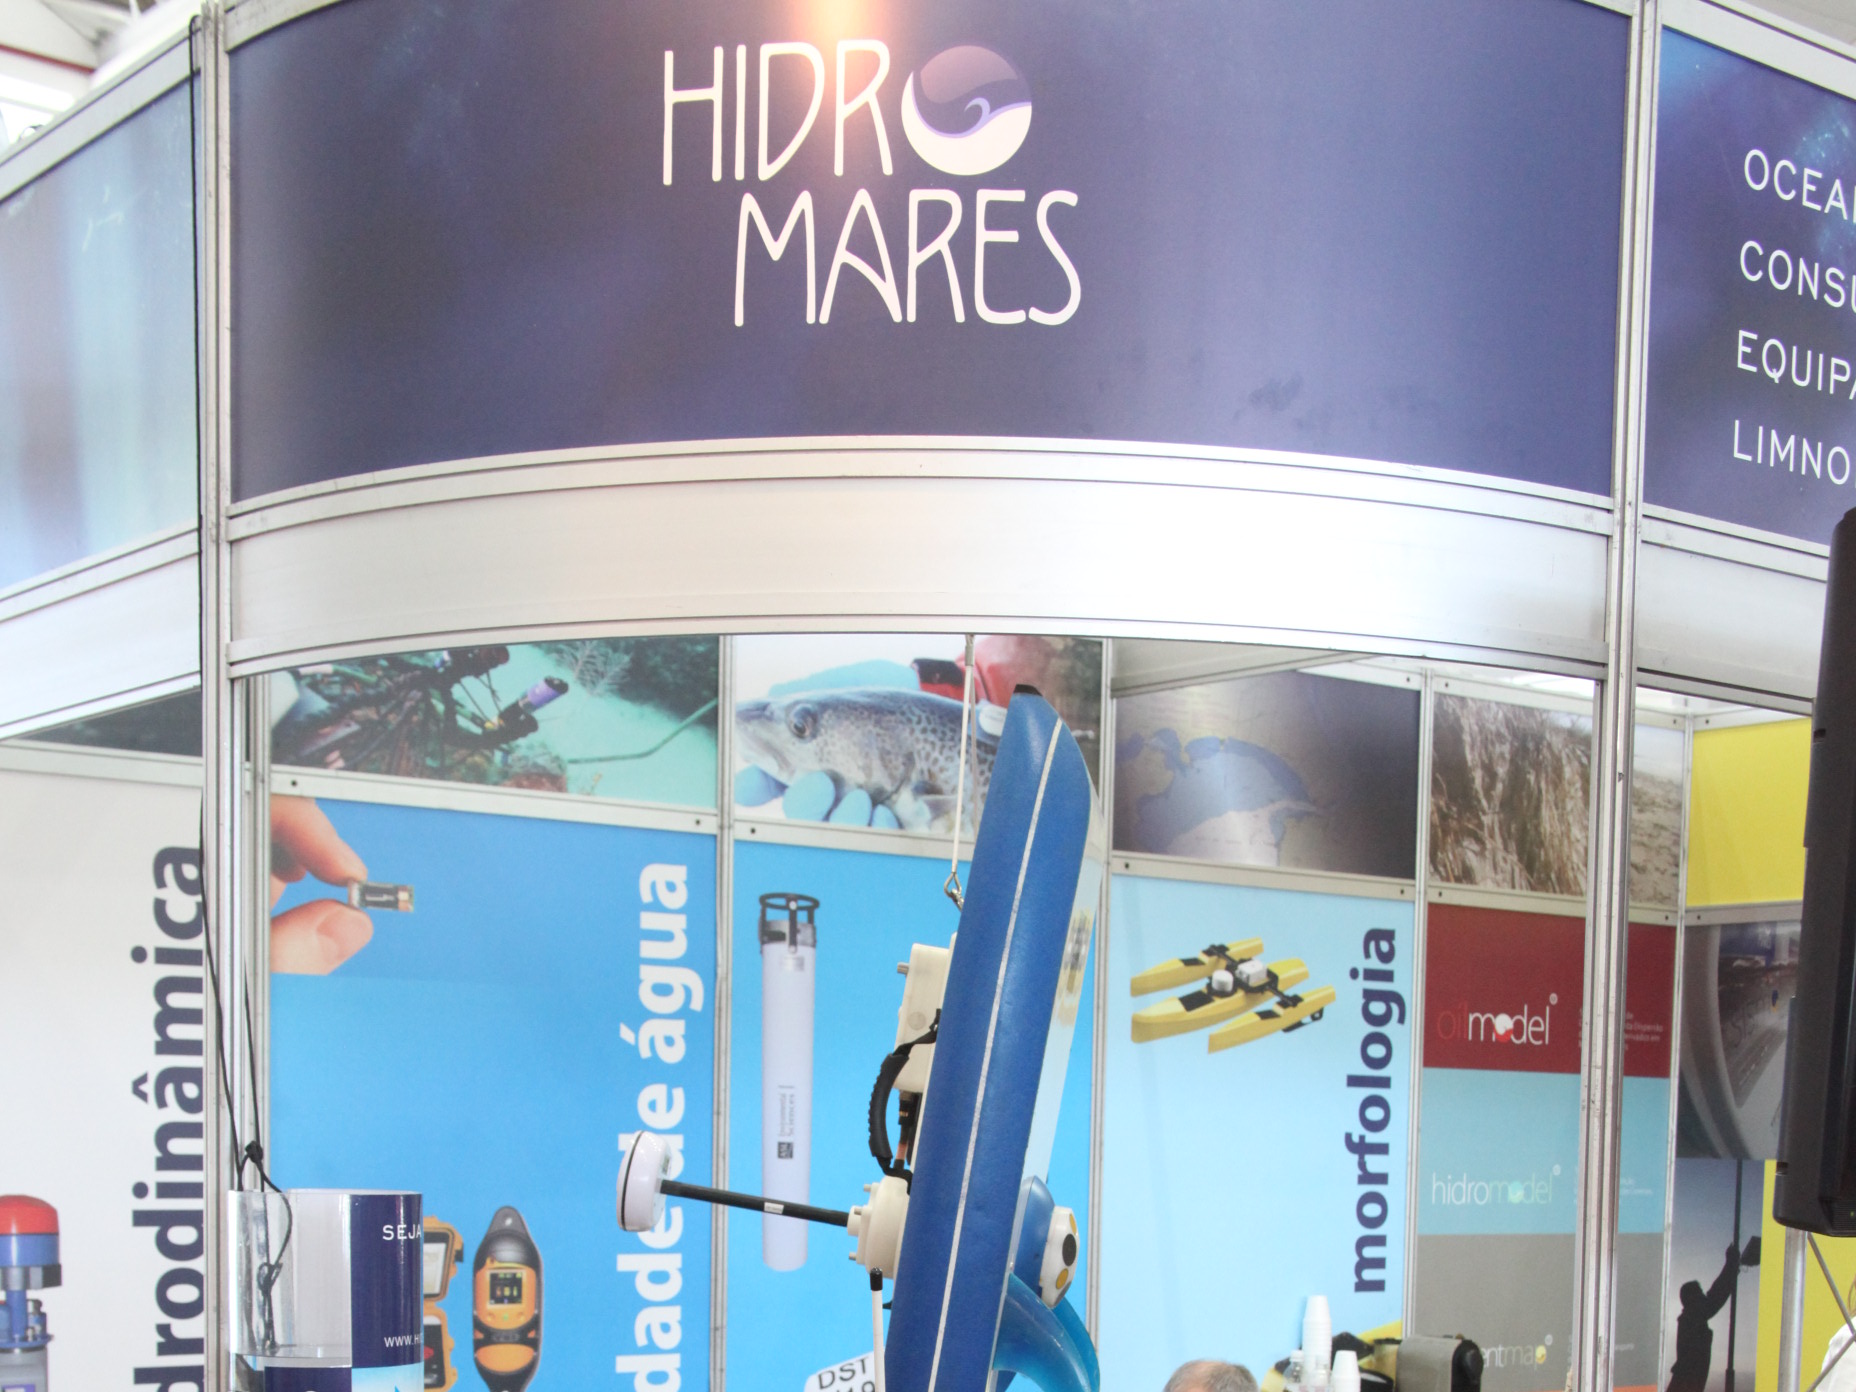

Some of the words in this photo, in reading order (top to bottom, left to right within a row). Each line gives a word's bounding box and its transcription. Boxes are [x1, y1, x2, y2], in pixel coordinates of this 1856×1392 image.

[1744, 148, 1856, 224] OCEA
[734, 188, 1082, 327] MARES
[1739, 240, 1856, 314] CONS
[1733, 419, 1856, 490] LIMNO
[619, 862, 704, 1065] água
[1344, 927, 1406, 1293] morfologia
[382, 1223, 422, 1241] SEJA
[818, 1355, 870, 1390] DST
